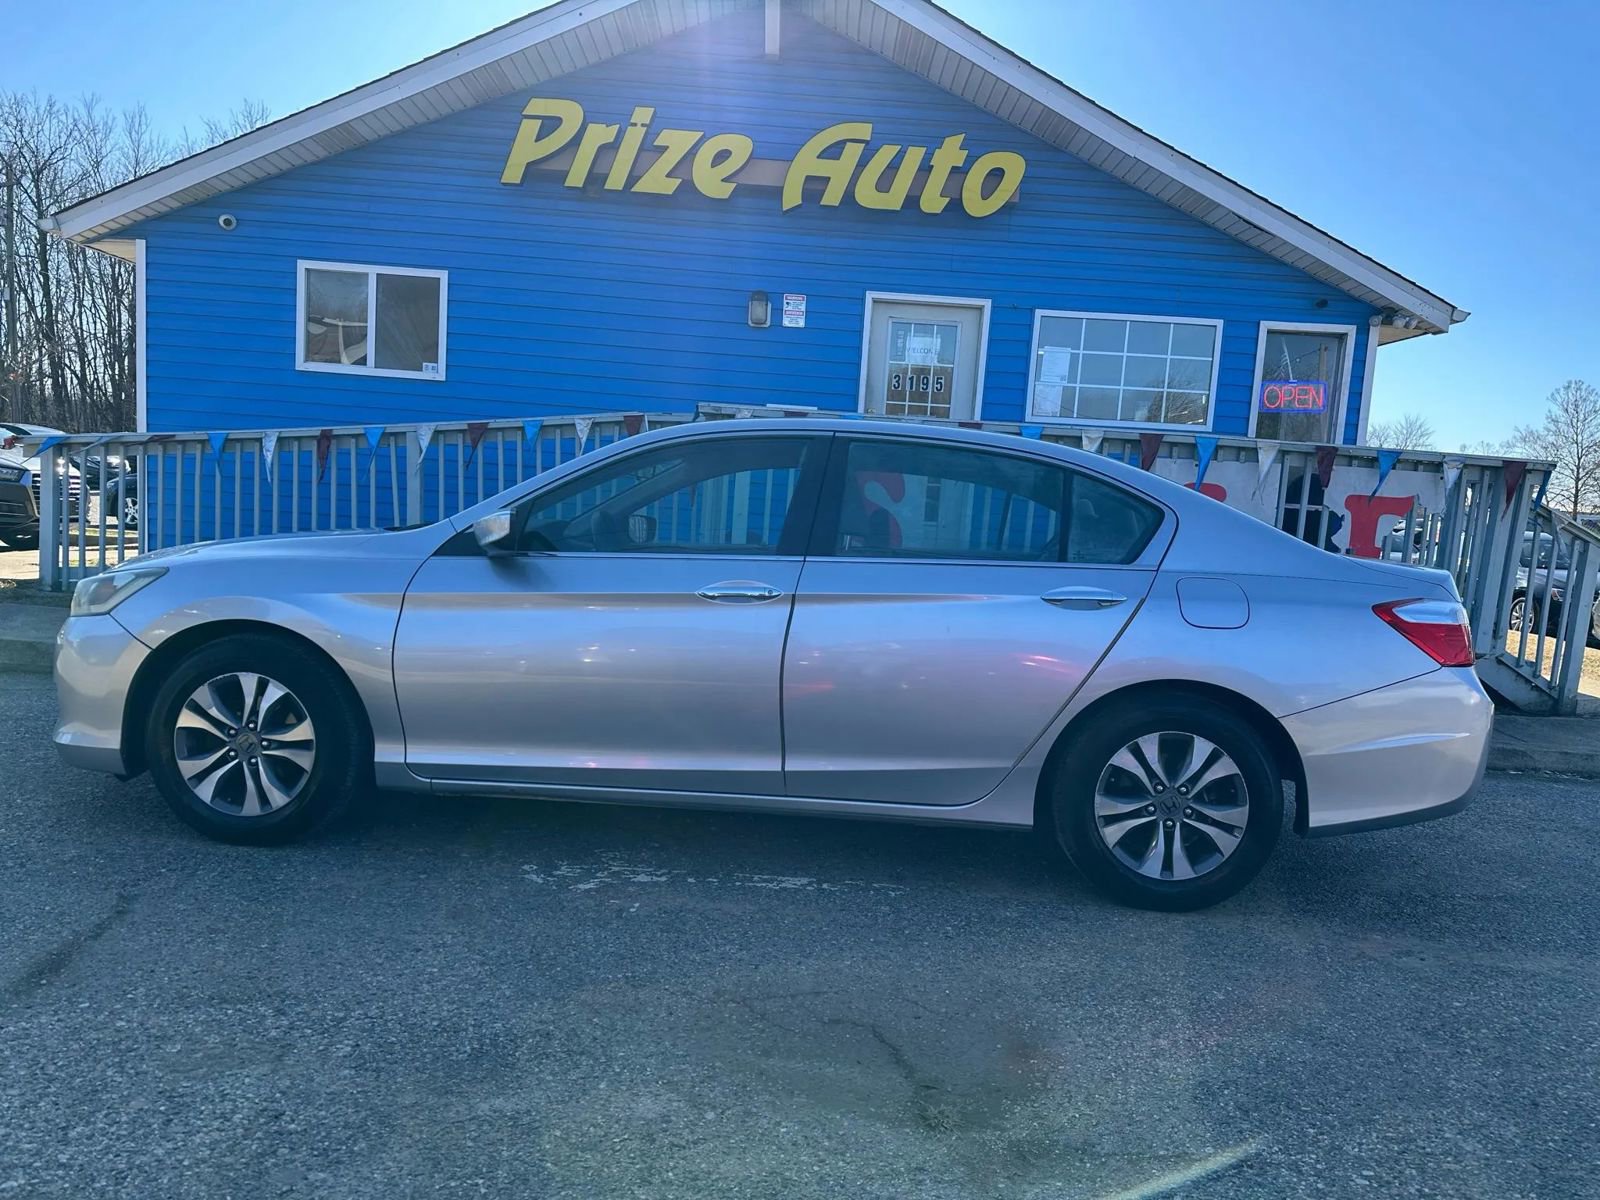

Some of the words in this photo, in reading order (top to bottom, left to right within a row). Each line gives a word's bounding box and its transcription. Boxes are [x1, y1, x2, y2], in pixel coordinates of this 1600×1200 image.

[500, 97, 753, 199] Prize
[781, 122, 1027, 218] Auto
[893, 374, 943, 392] 3195
[1263, 385, 1323, 409] OPEN
